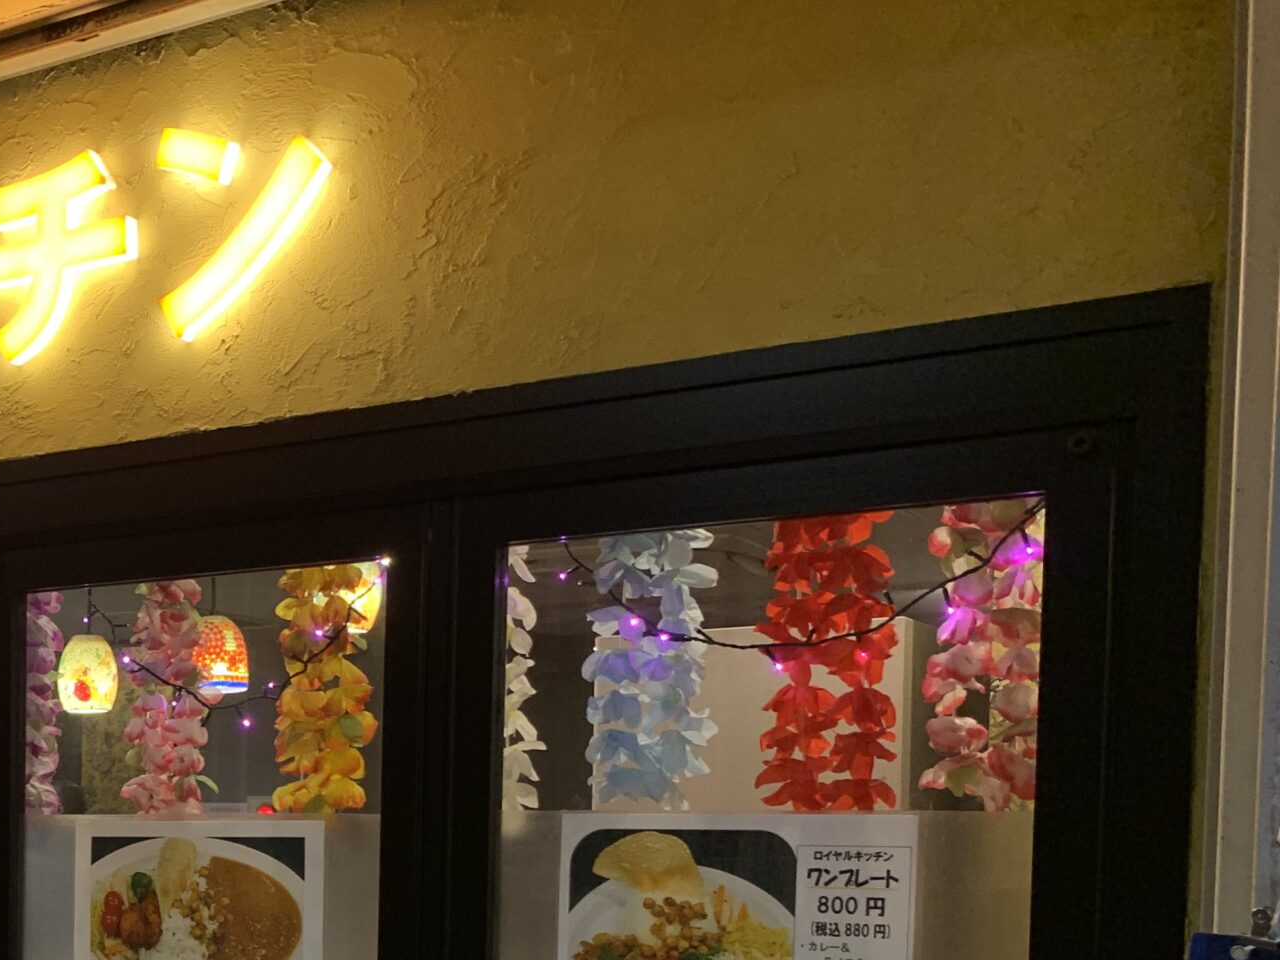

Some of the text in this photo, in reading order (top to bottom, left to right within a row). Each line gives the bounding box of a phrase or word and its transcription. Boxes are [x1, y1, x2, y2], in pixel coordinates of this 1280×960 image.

[813, 851, 893, 862] ロイヤルキッチン
[807, 868, 899, 889] ワンプレート
